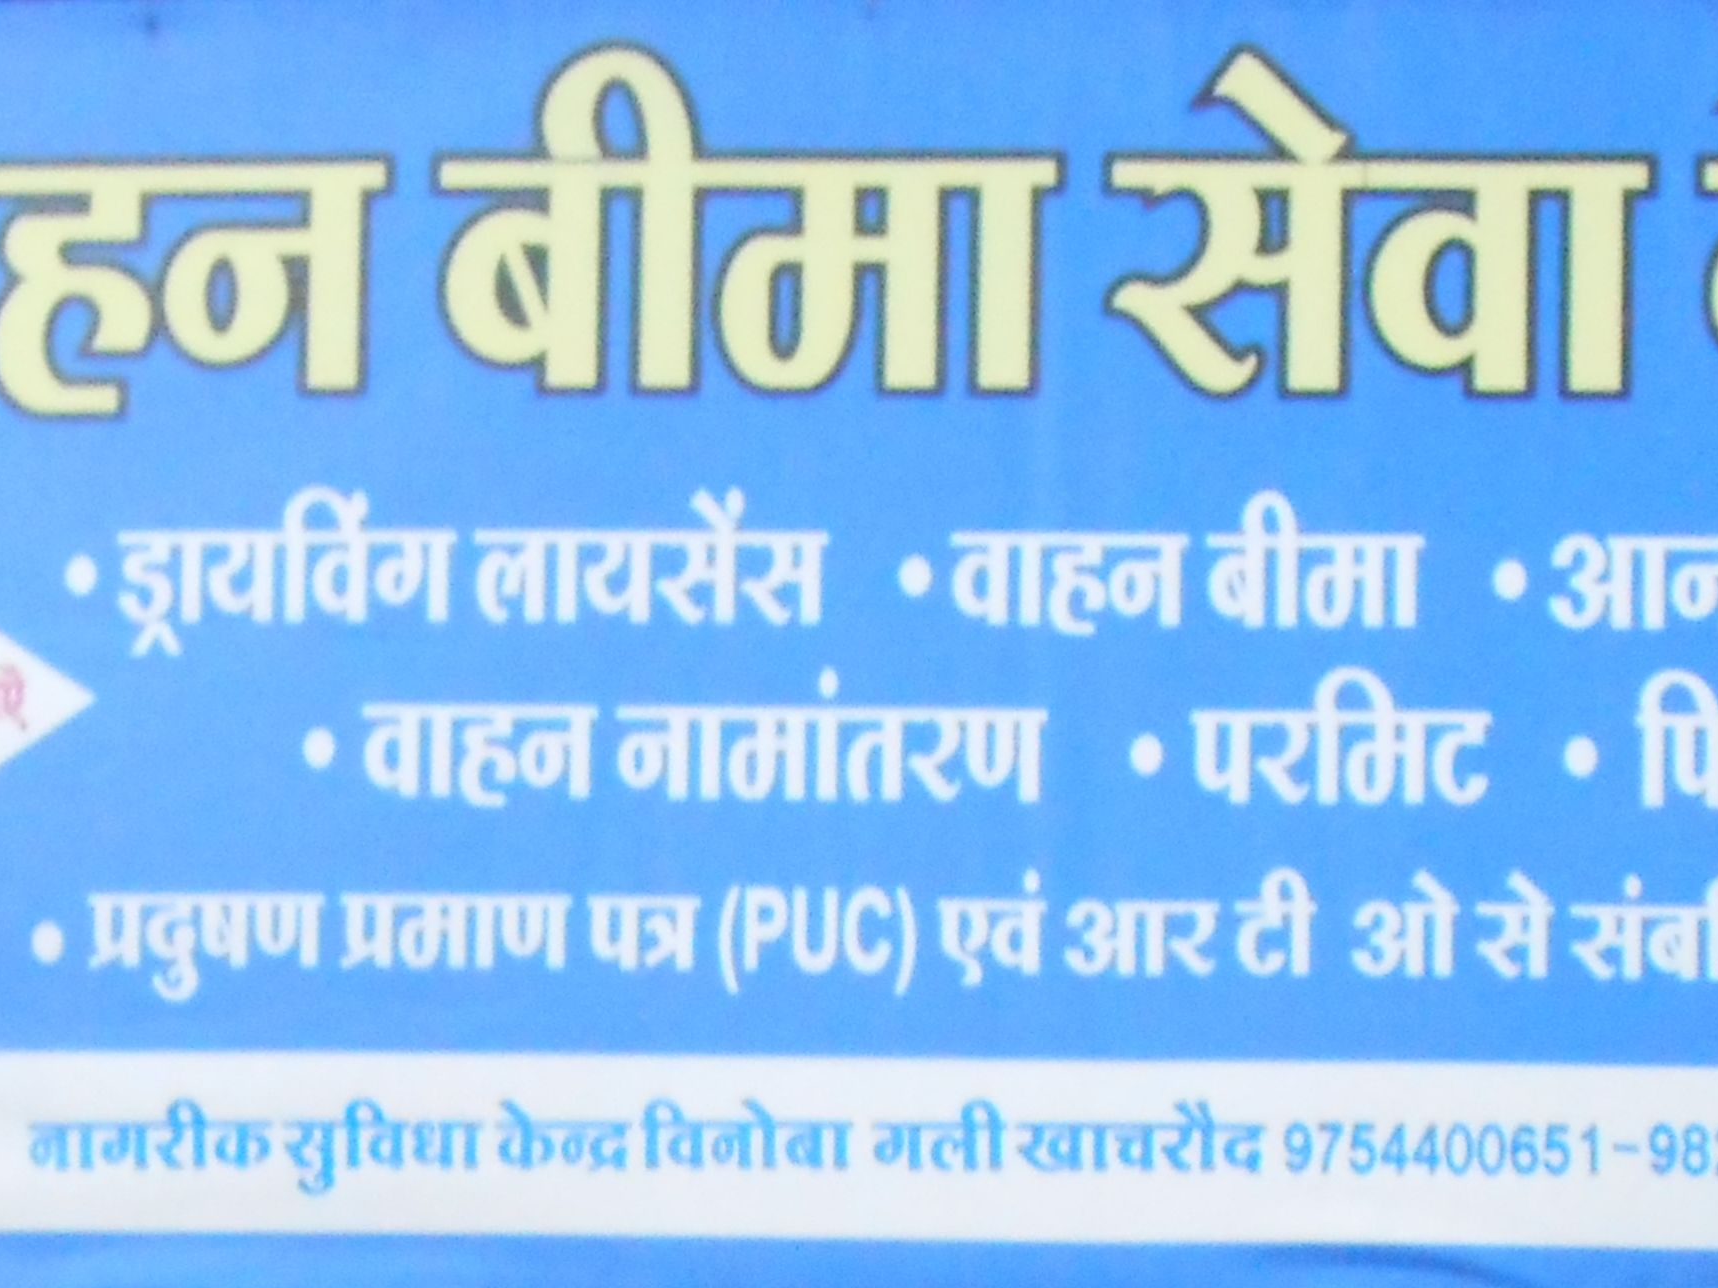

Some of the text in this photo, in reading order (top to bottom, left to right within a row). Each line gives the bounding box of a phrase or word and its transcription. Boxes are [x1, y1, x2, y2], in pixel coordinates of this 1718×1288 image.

[435, 42, 1063, 396] बीमा
[1103, 42, 1655, 396] सेवा
[951, 490, 1425, 636] वाहन बीमा
[363, 668, 1049, 808] वाहन नामांतरण
[1193, 667, 1493, 806] परमिट
[89, 892, 325, 1001] प्रदुषण
[341, 893, 572, 969] प्रमाण
[589, 894, 701, 971] पत्र
[719, 886, 918, 993] (PUC)
[939, 868, 1047, 985] एवं
[1066, 900, 1219, 976] आर
[1238, 868, 1317, 976] टी
[1353, 871, 1460, 977] ओ
[1476, 873, 1555, 978] से
[283, 1098, 484, 1196] सुविधा
[497, 1099, 632, 1171] केन्द्र
[639, 1098, 854, 1170] विनोबा
[873, 1098, 1008, 1172] गली
